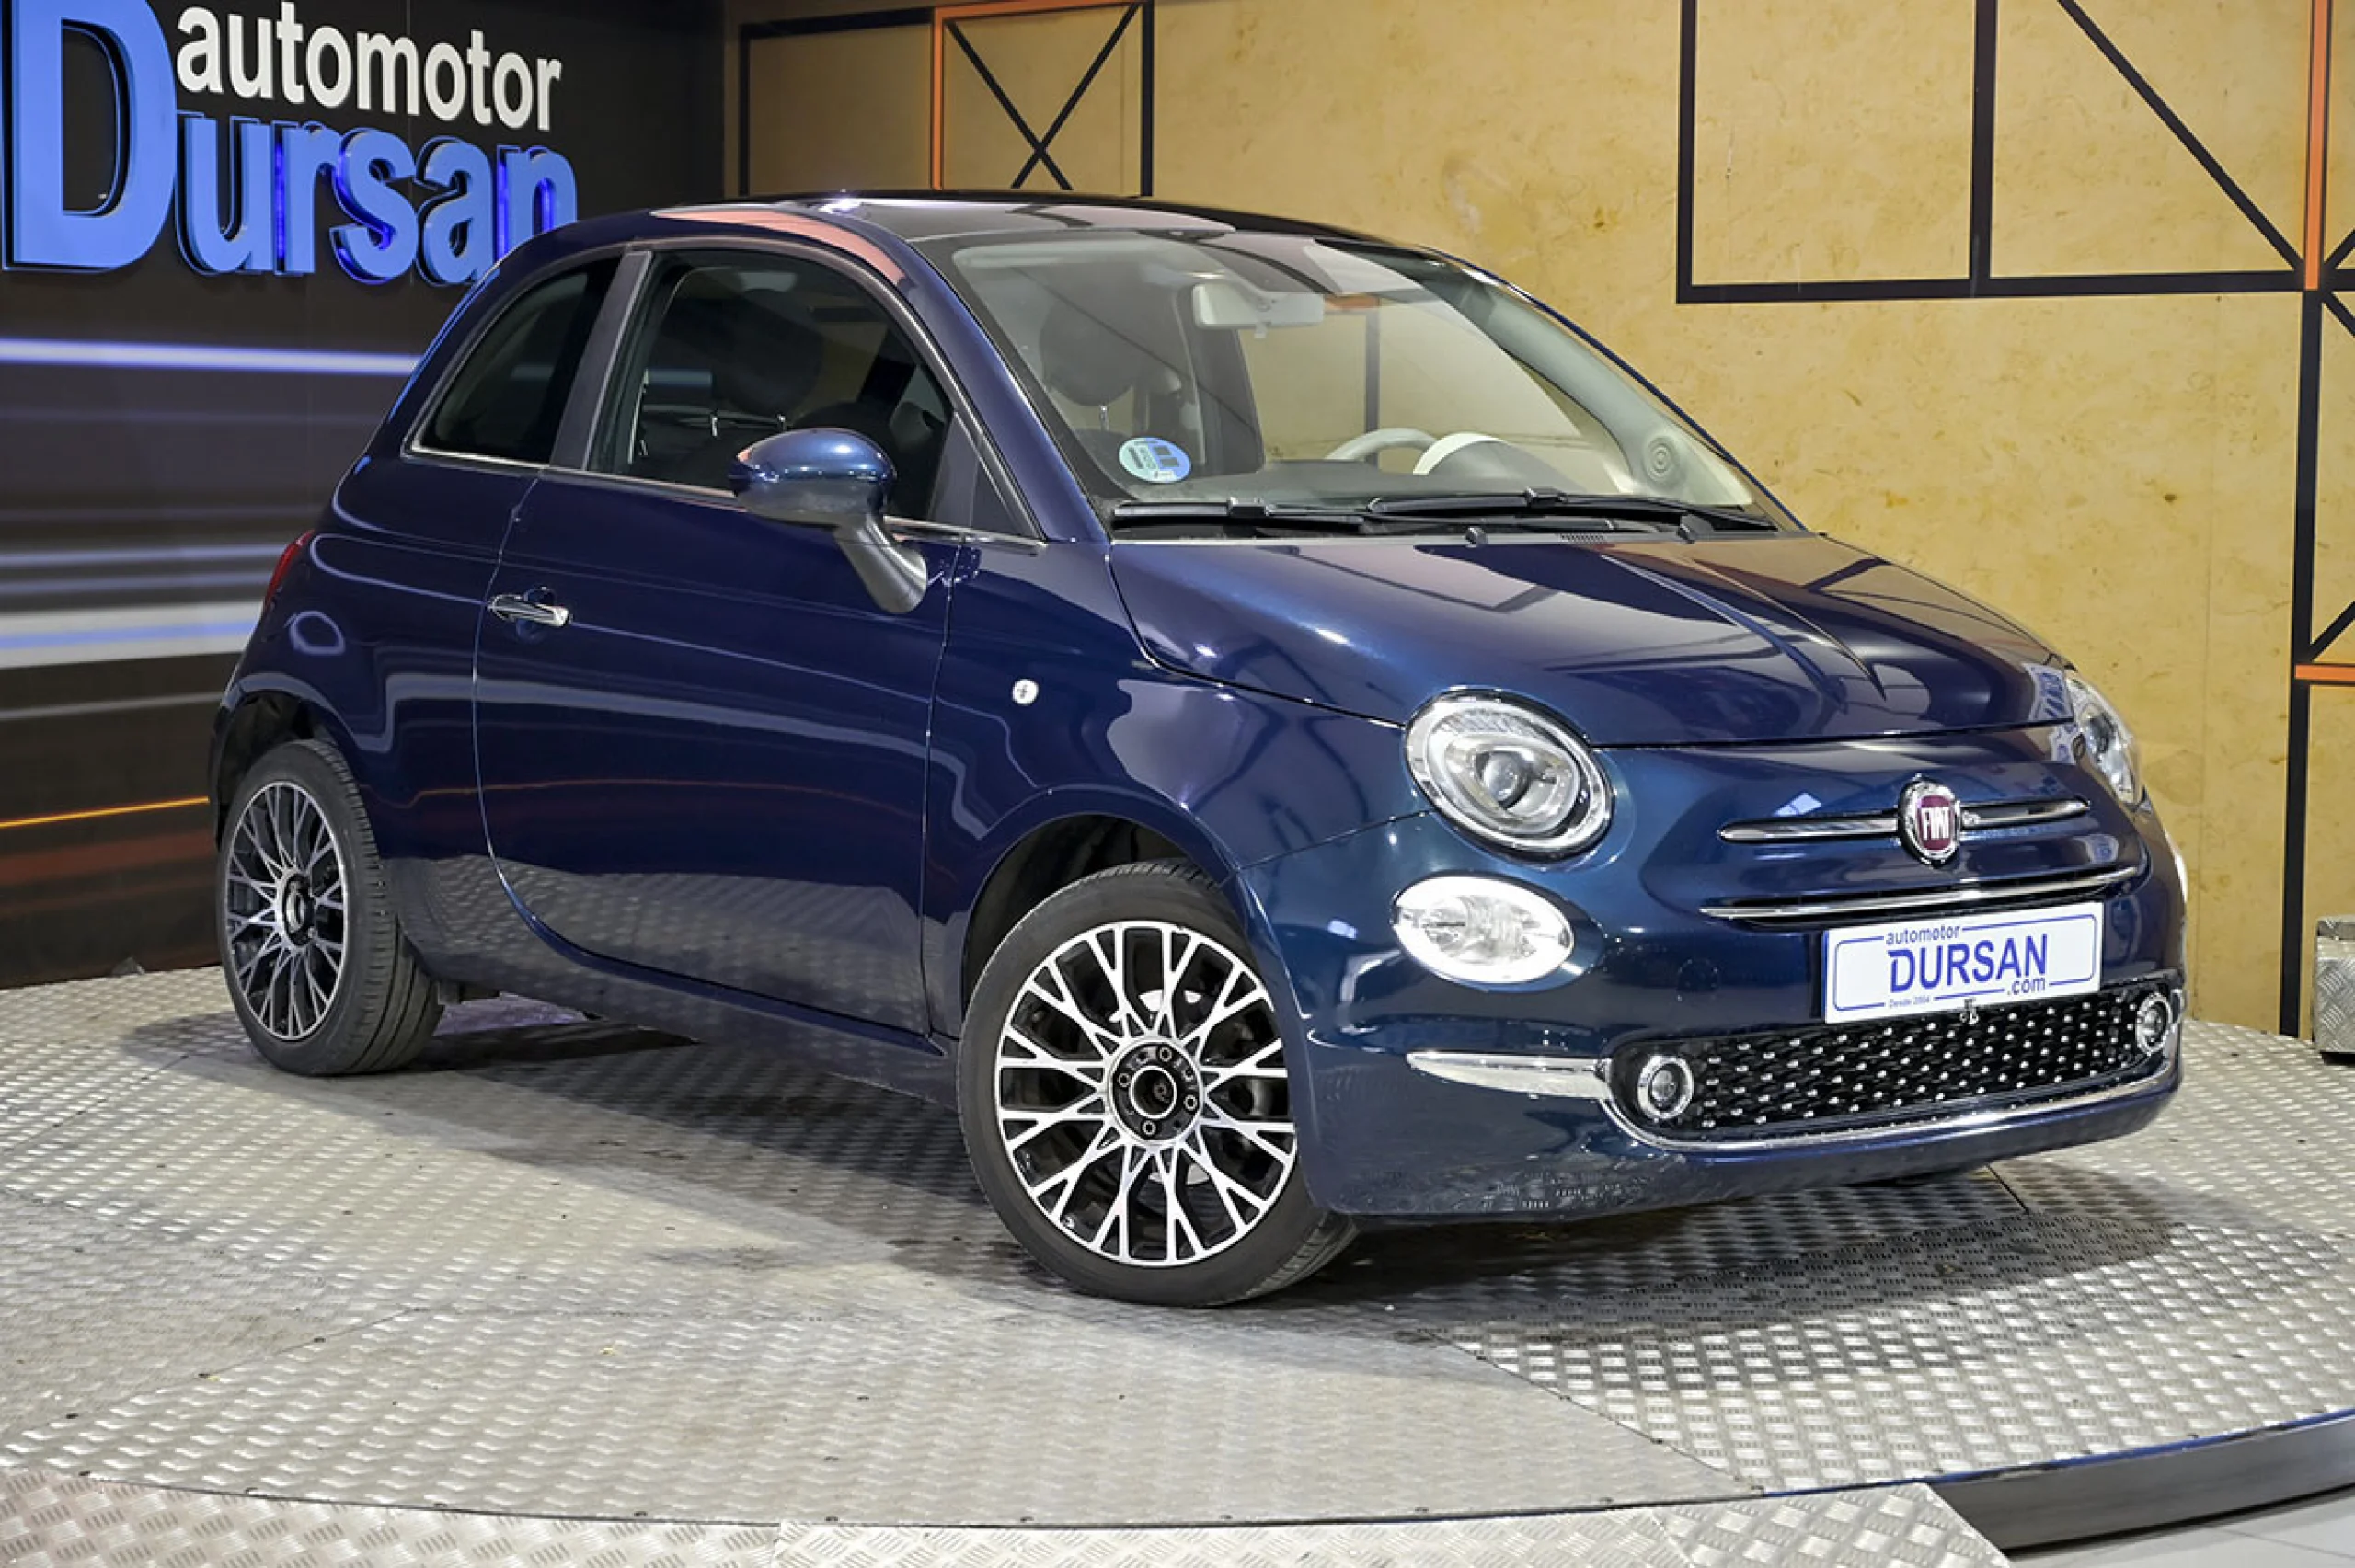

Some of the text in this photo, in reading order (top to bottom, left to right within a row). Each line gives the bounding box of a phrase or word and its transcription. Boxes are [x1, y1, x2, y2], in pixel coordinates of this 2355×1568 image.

[177, 3, 562, 131] automotor
[3, 0, 578, 287] Dursan
[1920, 806, 1950, 841] FIAT
[1886, 925, 1960, 945] automotor
[1887, 933, 2048, 993] DURSAN
[2007, 977, 2046, 996] .com
